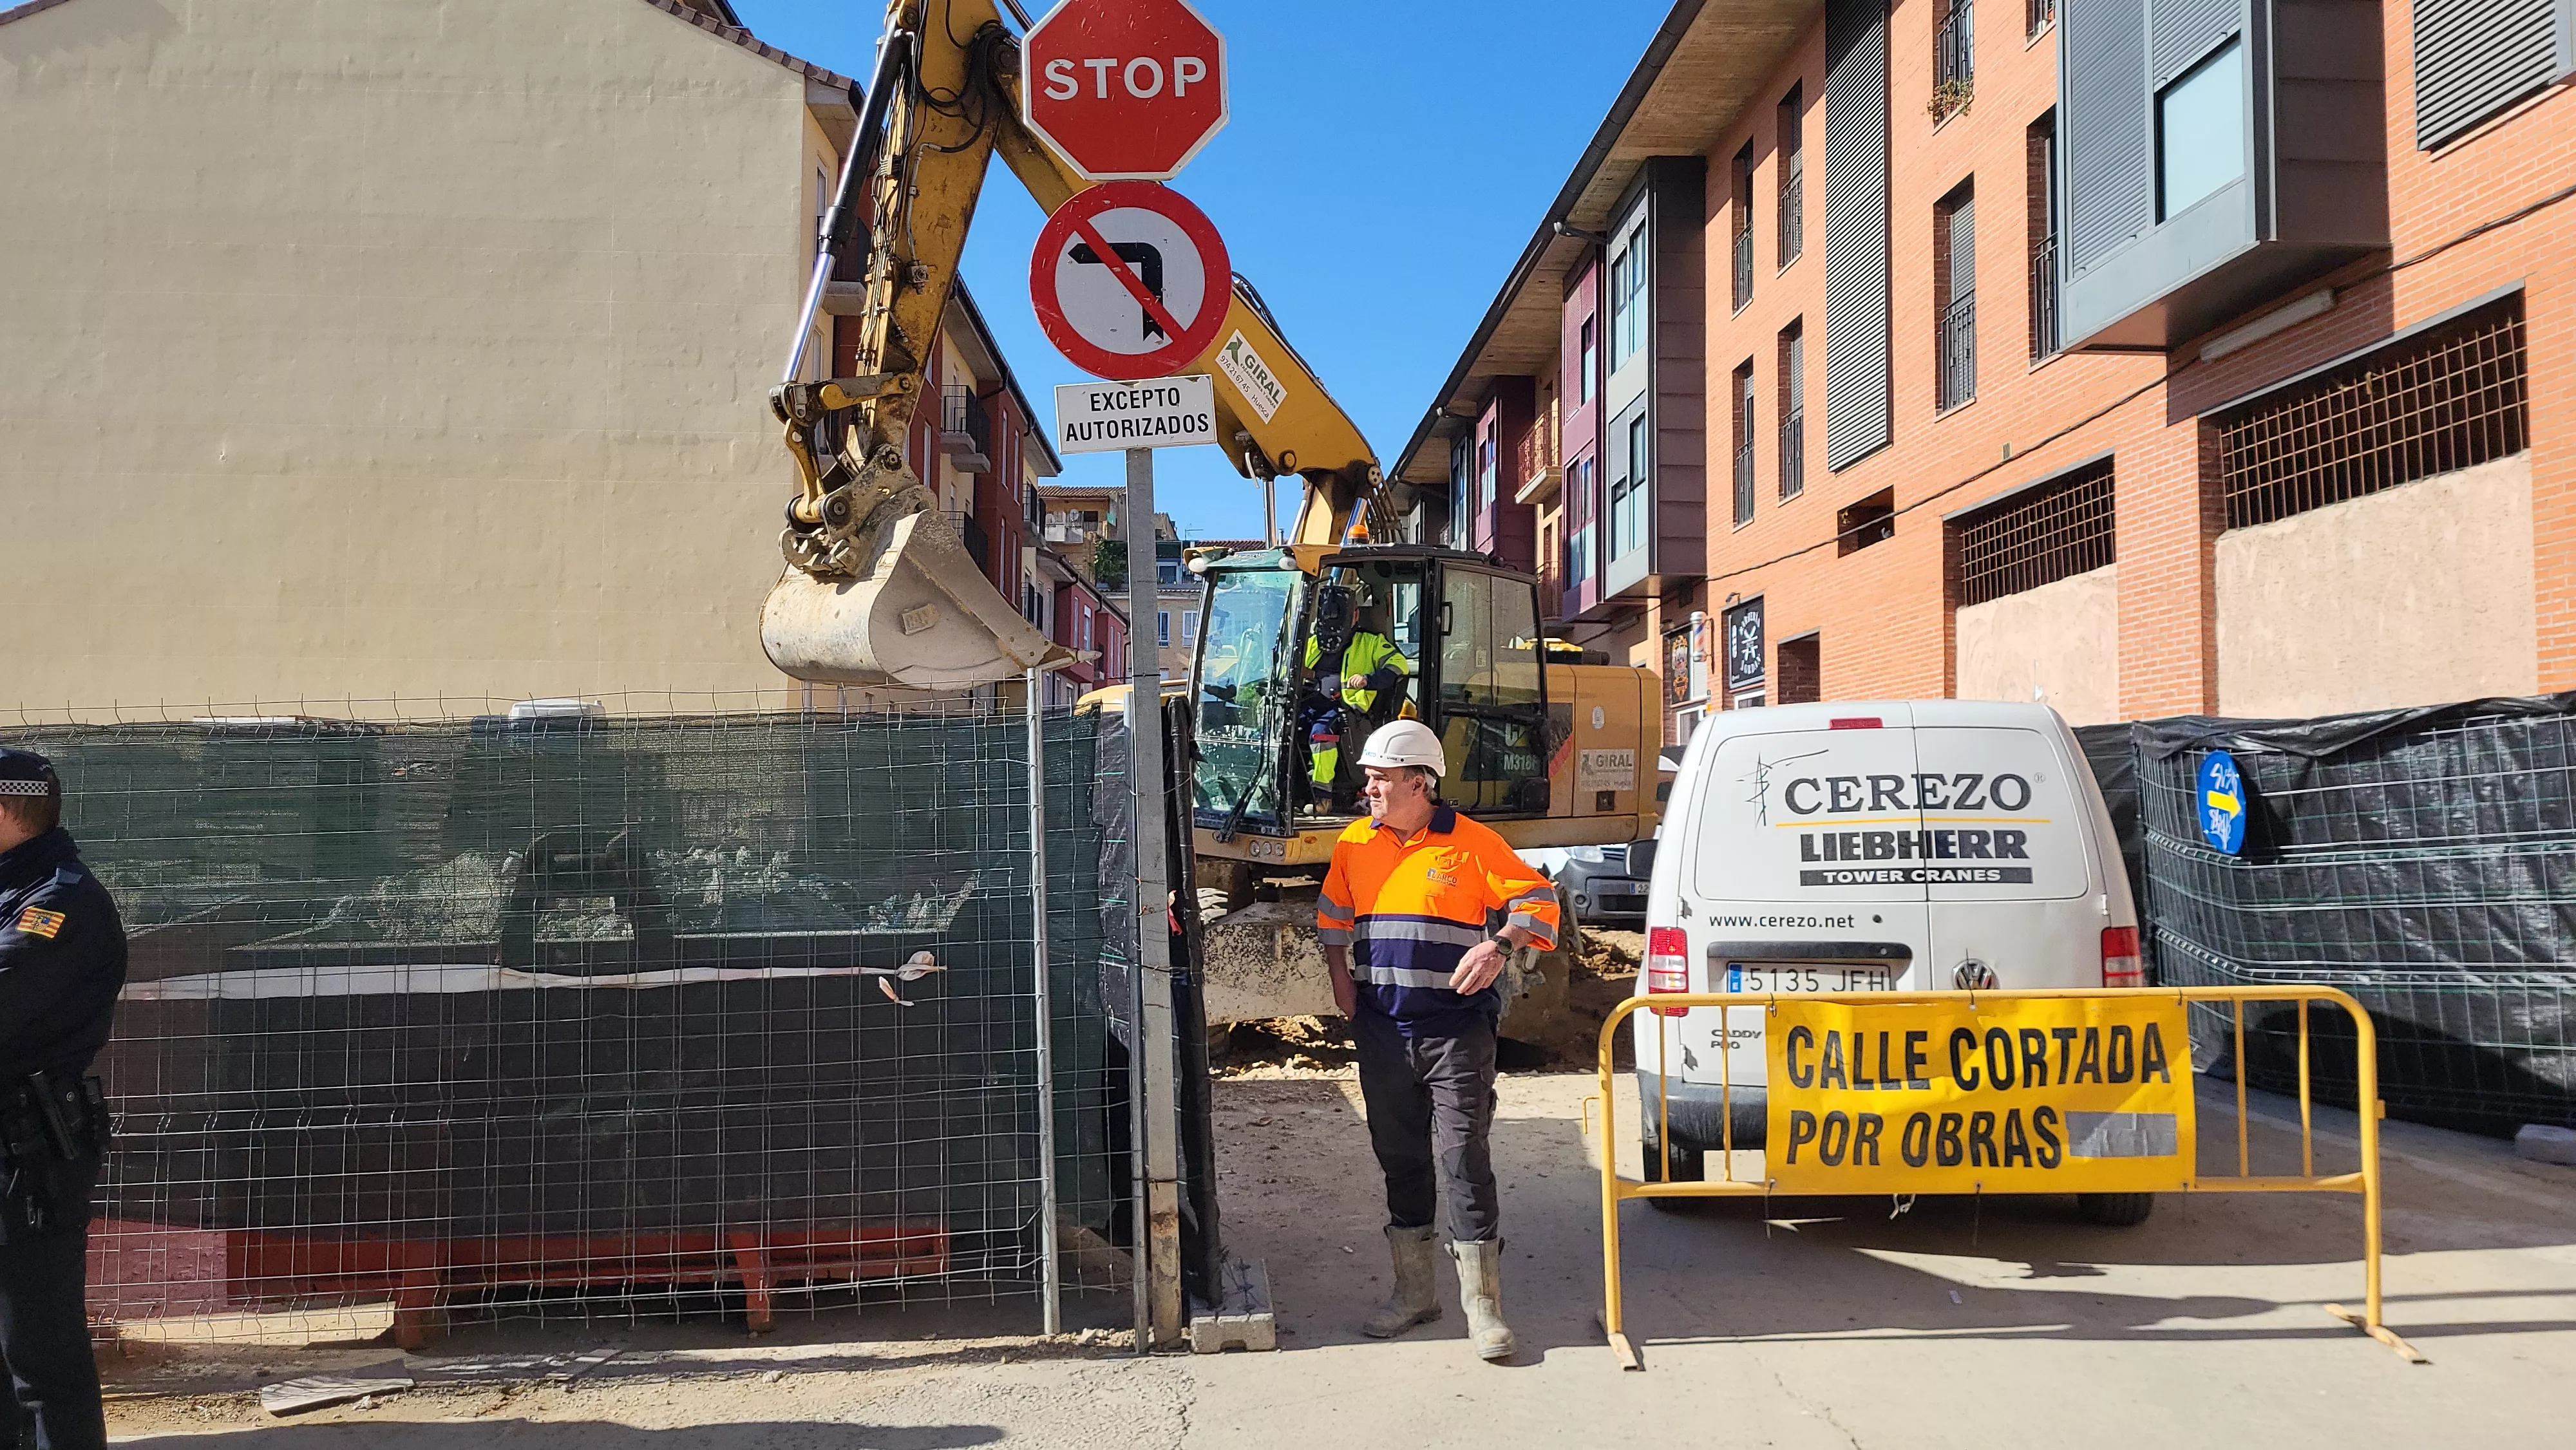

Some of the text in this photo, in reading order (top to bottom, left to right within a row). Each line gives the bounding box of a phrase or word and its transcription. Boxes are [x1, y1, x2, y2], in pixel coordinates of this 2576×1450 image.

[1043, 56, 1207, 100] STOP
[1220, 355, 1231, 369] 974
[1229, 368, 1237, 377] 21
[1251, 394, 1269, 419] Huesca
[1244, 354, 1279, 404] GIRAL
[1090, 387, 1180, 411] EXCEPTO
[1065, 413, 1209, 442] AUTORIZADOS
[1596, 754, 1633, 767] GIRAL
[1785, 773, 2032, 815] CEREZO
[1800, 829, 2031, 862] LIEBHERR
[1823, 869, 2001, 883] TOWER CRANES
[1709, 914, 1855, 928] www.cerezo.net
[1749, 968, 1819, 992] 5135
[1710, 1040, 1741, 1050] PO
[1786, 1022, 2172, 1091] CALLE CORTADA
[1786, 1105, 2062, 1169] POR OBRAS
